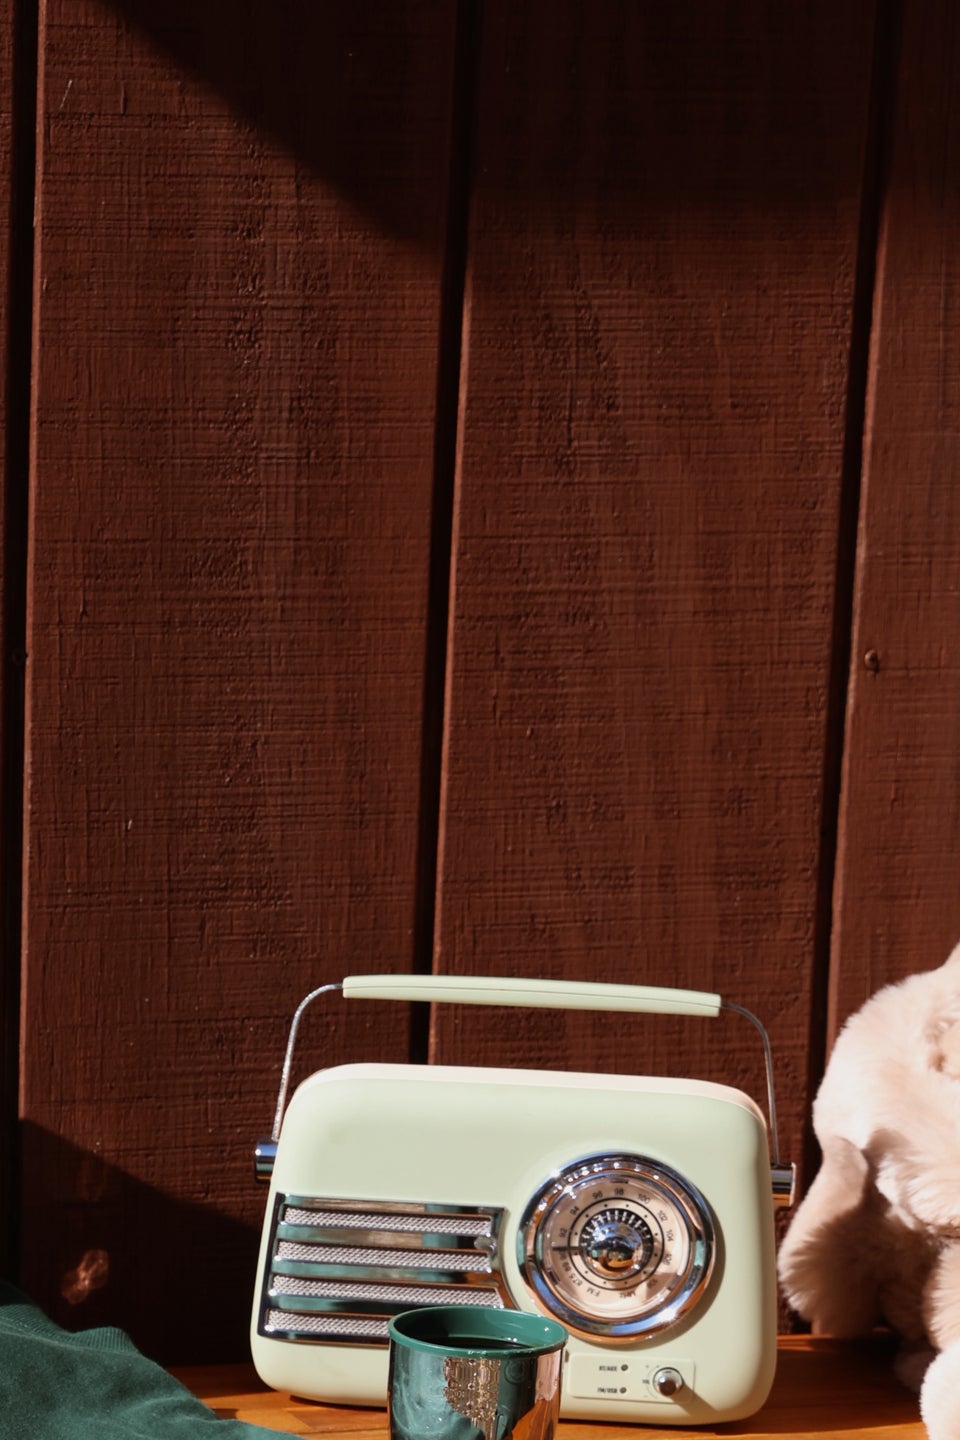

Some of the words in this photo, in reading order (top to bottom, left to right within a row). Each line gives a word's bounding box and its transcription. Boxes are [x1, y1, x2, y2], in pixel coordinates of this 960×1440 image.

[614, 1188, 624, 1196] 98
[638, 1193, 650, 1204] 100
[658, 1210, 667, 1222] 102
[666, 1229, 674, 1242] 104
